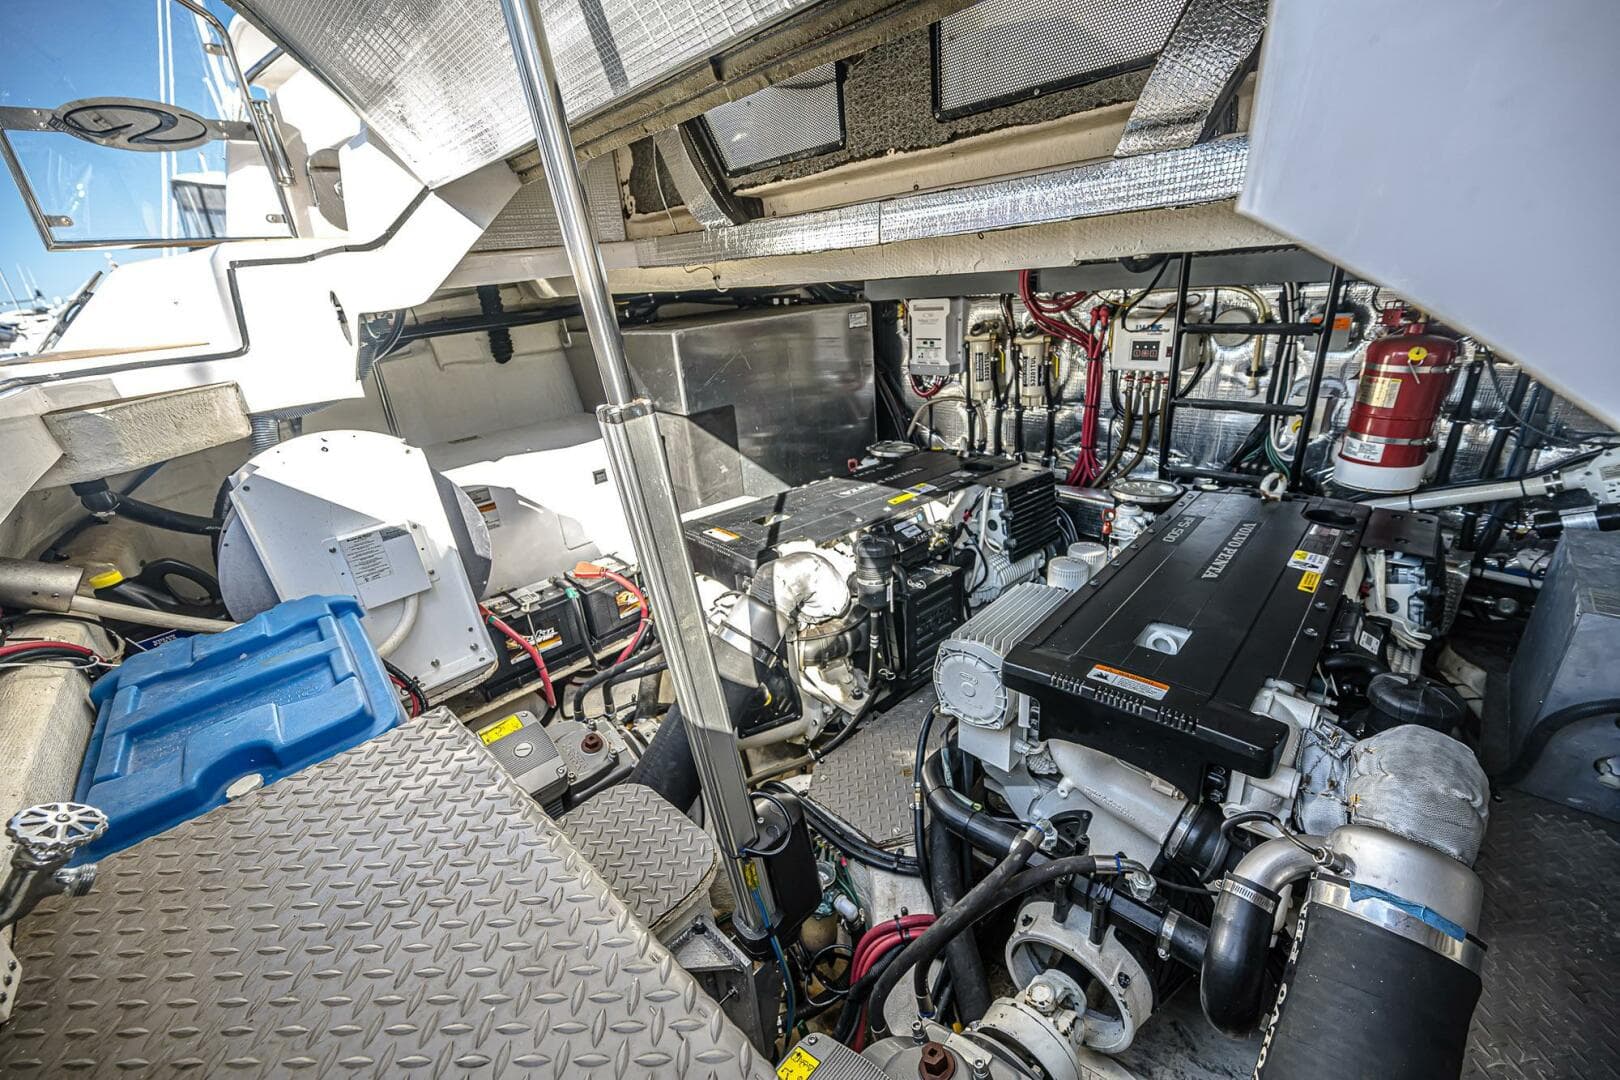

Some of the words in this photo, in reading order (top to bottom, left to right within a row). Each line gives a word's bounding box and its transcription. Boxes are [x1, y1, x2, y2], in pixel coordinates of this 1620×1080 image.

[1162, 527, 1185, 543] 500
[1228, 522, 1258, 548] VOLVO
[1201, 546, 1239, 579] PENTA
